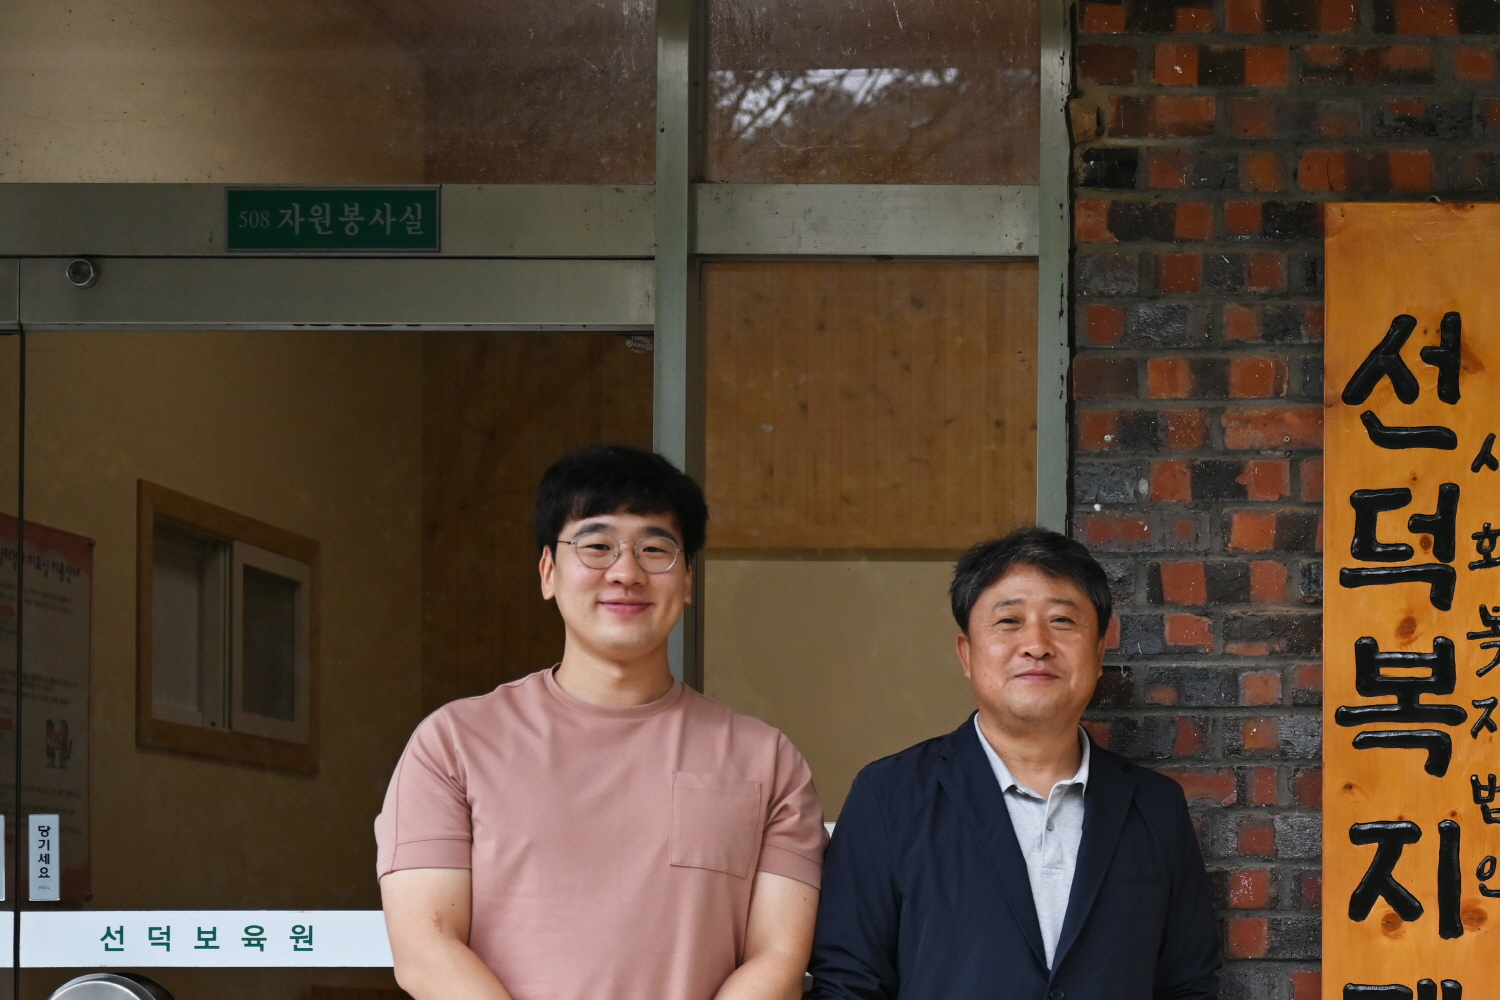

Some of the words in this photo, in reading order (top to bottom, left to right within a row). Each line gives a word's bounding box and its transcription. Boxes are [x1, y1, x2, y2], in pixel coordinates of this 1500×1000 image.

[238, 211, 270, 229] 508
[277, 203, 423, 235] 자원봉사실
[38, 825, 51, 879] 당기세요
[100, 924, 314, 952] 선덕보육원
